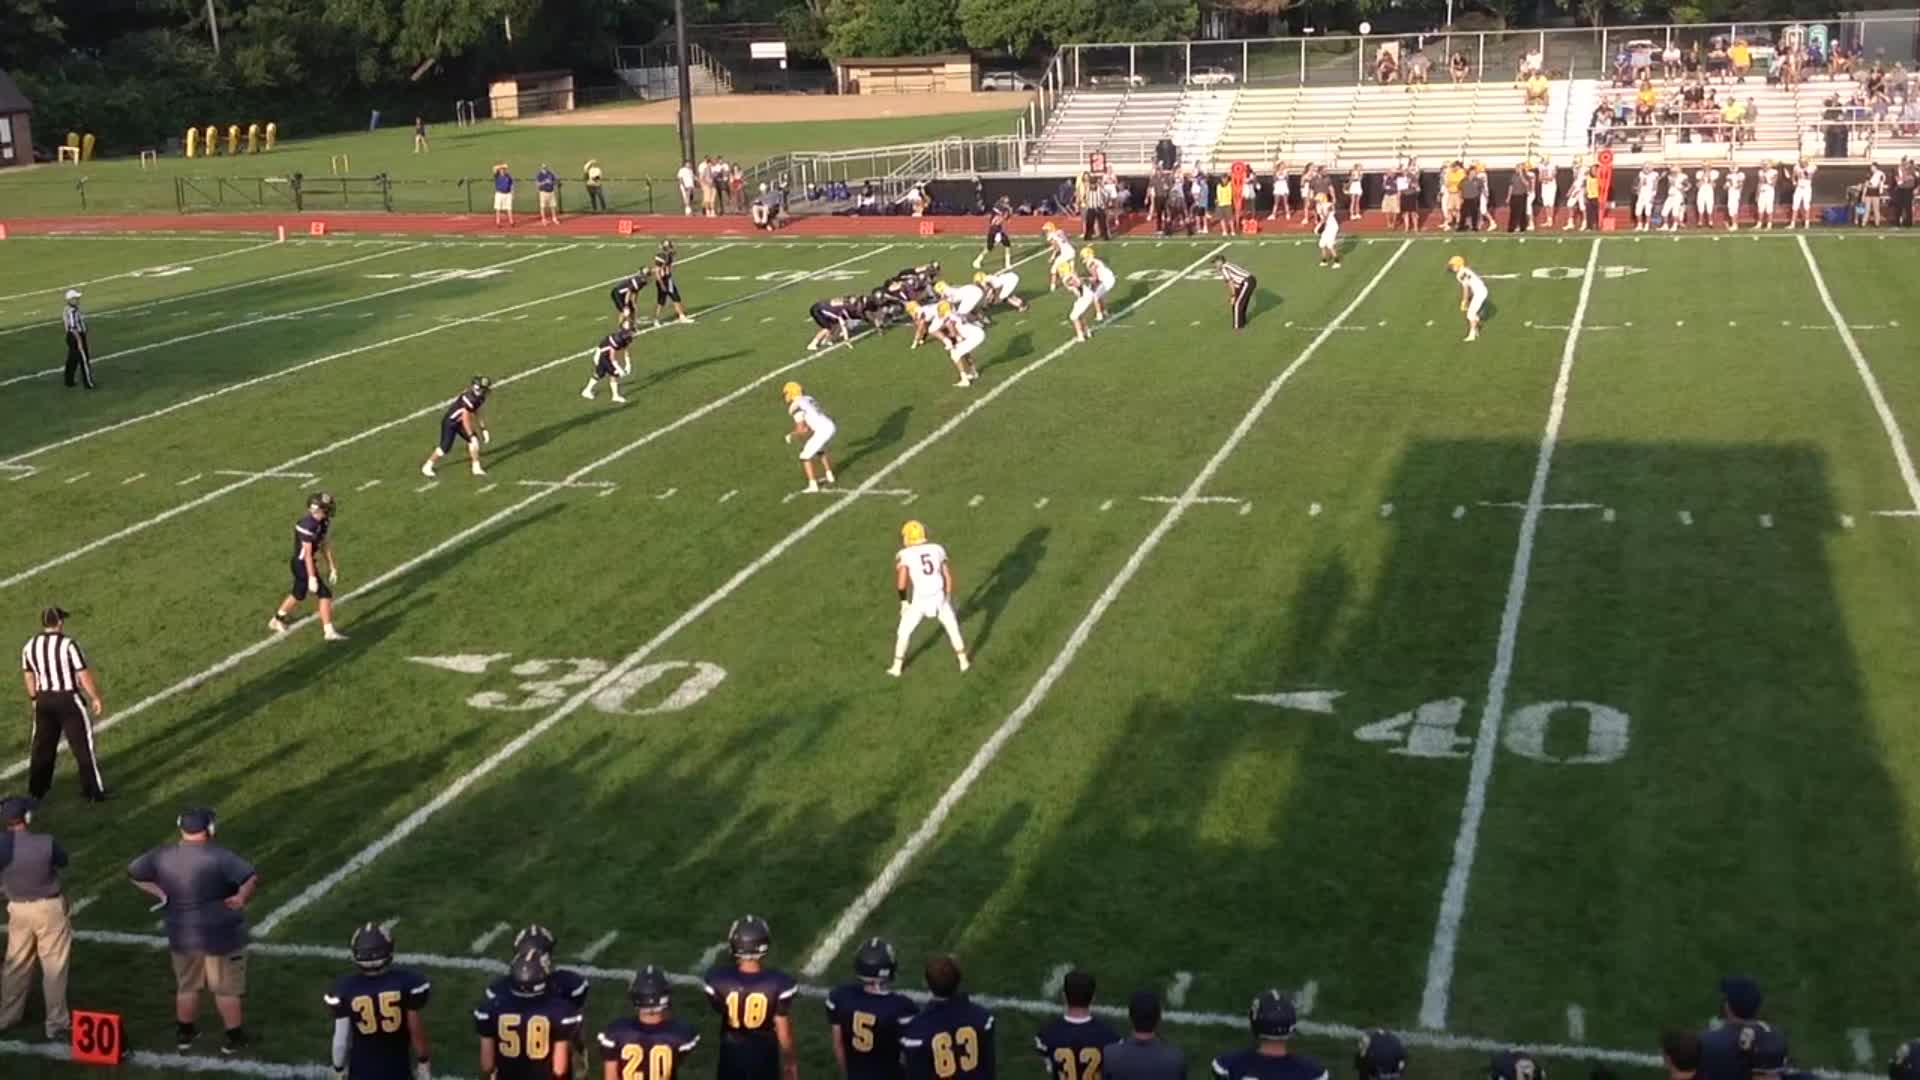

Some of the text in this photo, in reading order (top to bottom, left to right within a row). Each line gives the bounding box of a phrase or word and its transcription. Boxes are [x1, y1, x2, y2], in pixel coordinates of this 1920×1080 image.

[919, 553, 934, 576] 5
[466, 657, 727, 715] 30
[1354, 697, 1630, 763] 40
[350, 991, 401, 1035] 35
[851, 1010, 877, 1053] 5
[77, 1016, 115, 1056] 30
[497, 1013, 551, 1059] 58
[932, 1026, 979, 1079] 63
[1053, 1047, 1102, 1080] 32
